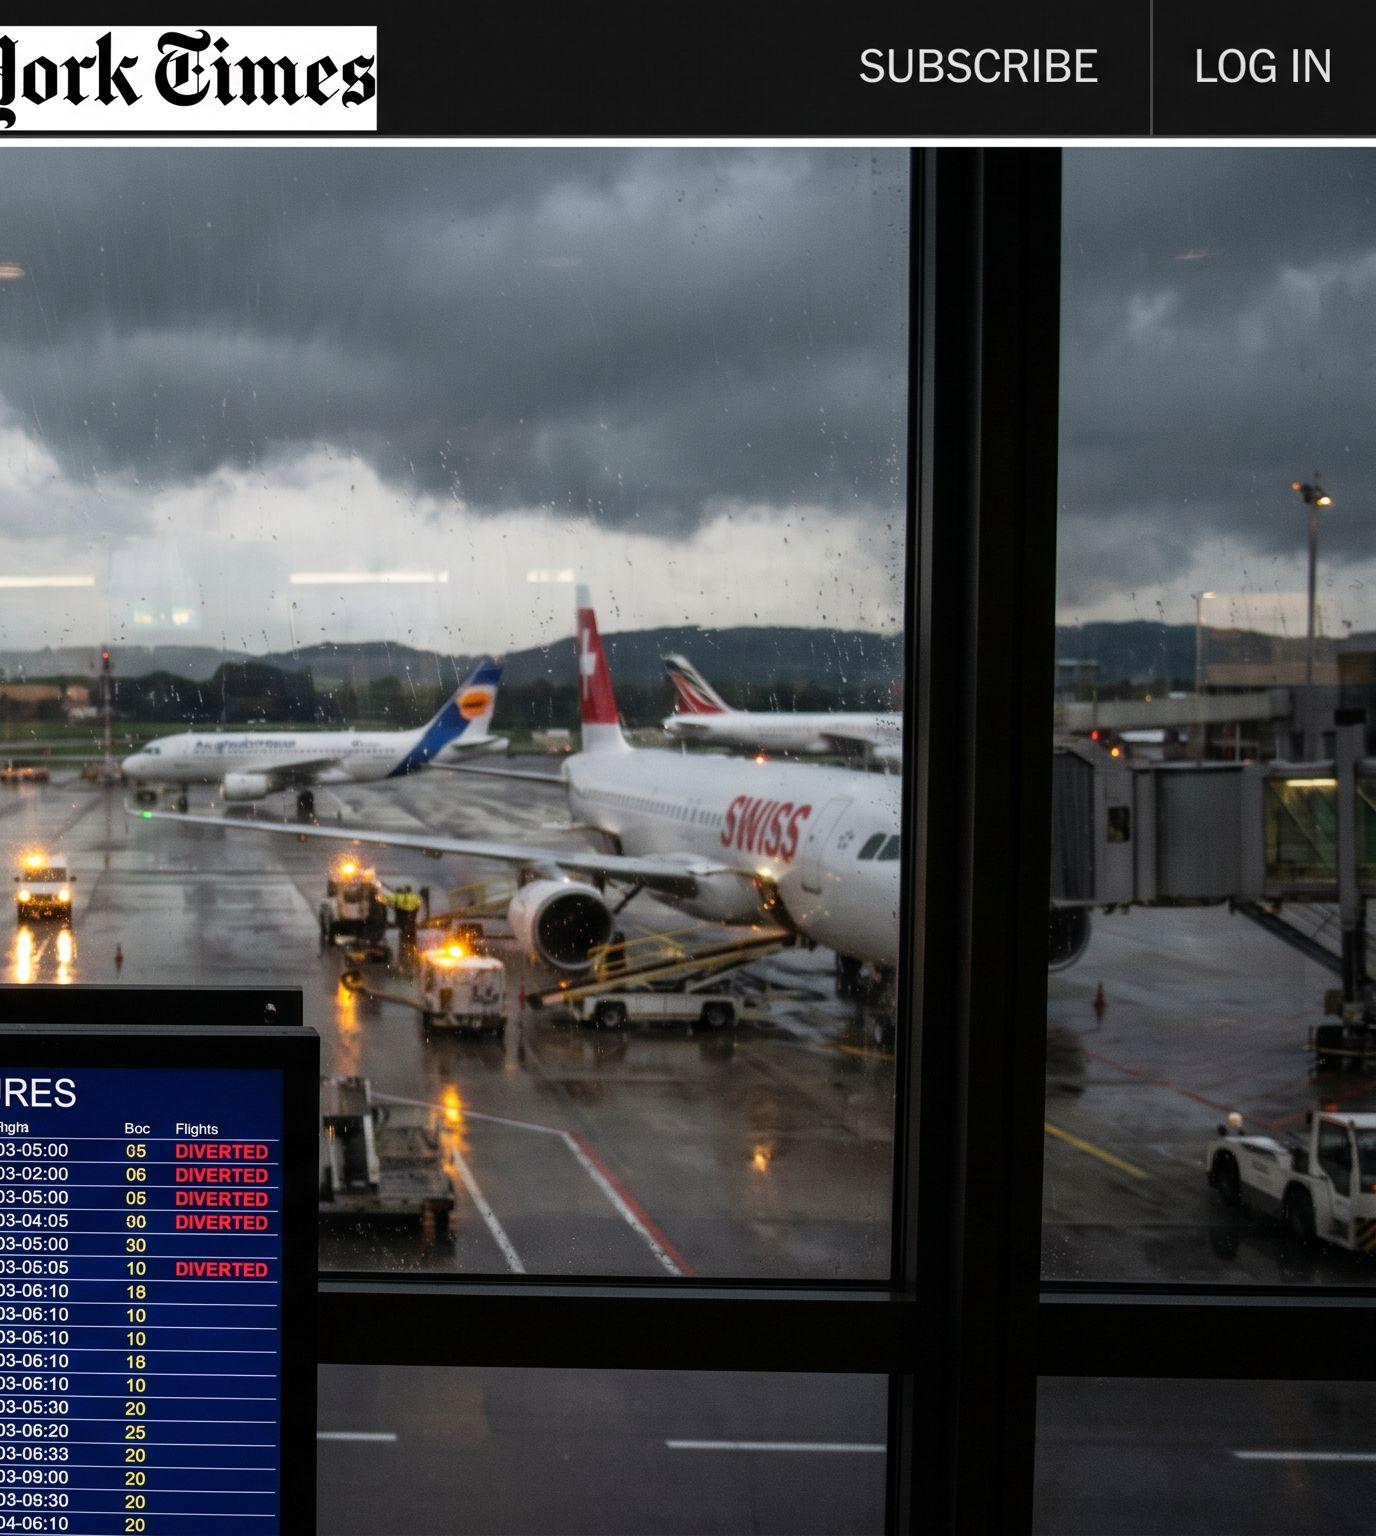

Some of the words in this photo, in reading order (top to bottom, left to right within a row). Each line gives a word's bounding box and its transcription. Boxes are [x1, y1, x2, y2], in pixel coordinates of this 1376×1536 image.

[720, 795, 812, 862] SWISS
[125, 1123, 150, 1134] Boc
[176, 1123, 218, 1137] Flights
[176, 1144, 268, 1159] DIVERTED
[126, 1168, 146, 1181] 06
[176, 1168, 268, 1182] DIVERTED
[176, 1192, 268, 1206] DIVERTED
[176, 1215, 268, 1230] DIVERTED
[127, 1239, 146, 1252] 30
[127, 1262, 146, 1275] 10
[176, 1262, 268, 1277] DIVERTED
[127, 1285, 146, 1299] 18
[127, 1309, 146, 1322] 10
[127, 1332, 145, 1345] 10
[127, 1379, 145, 1392] 10
[126, 1402, 145, 1415] 20
[125, 1425, 145, 1439] 25
[126, 1449, 145, 1462] 20
[126, 1472, 145, 1485] 20
[126, 1495, 145, 1508] 20
[125, 1518, 145, 1531] 20
